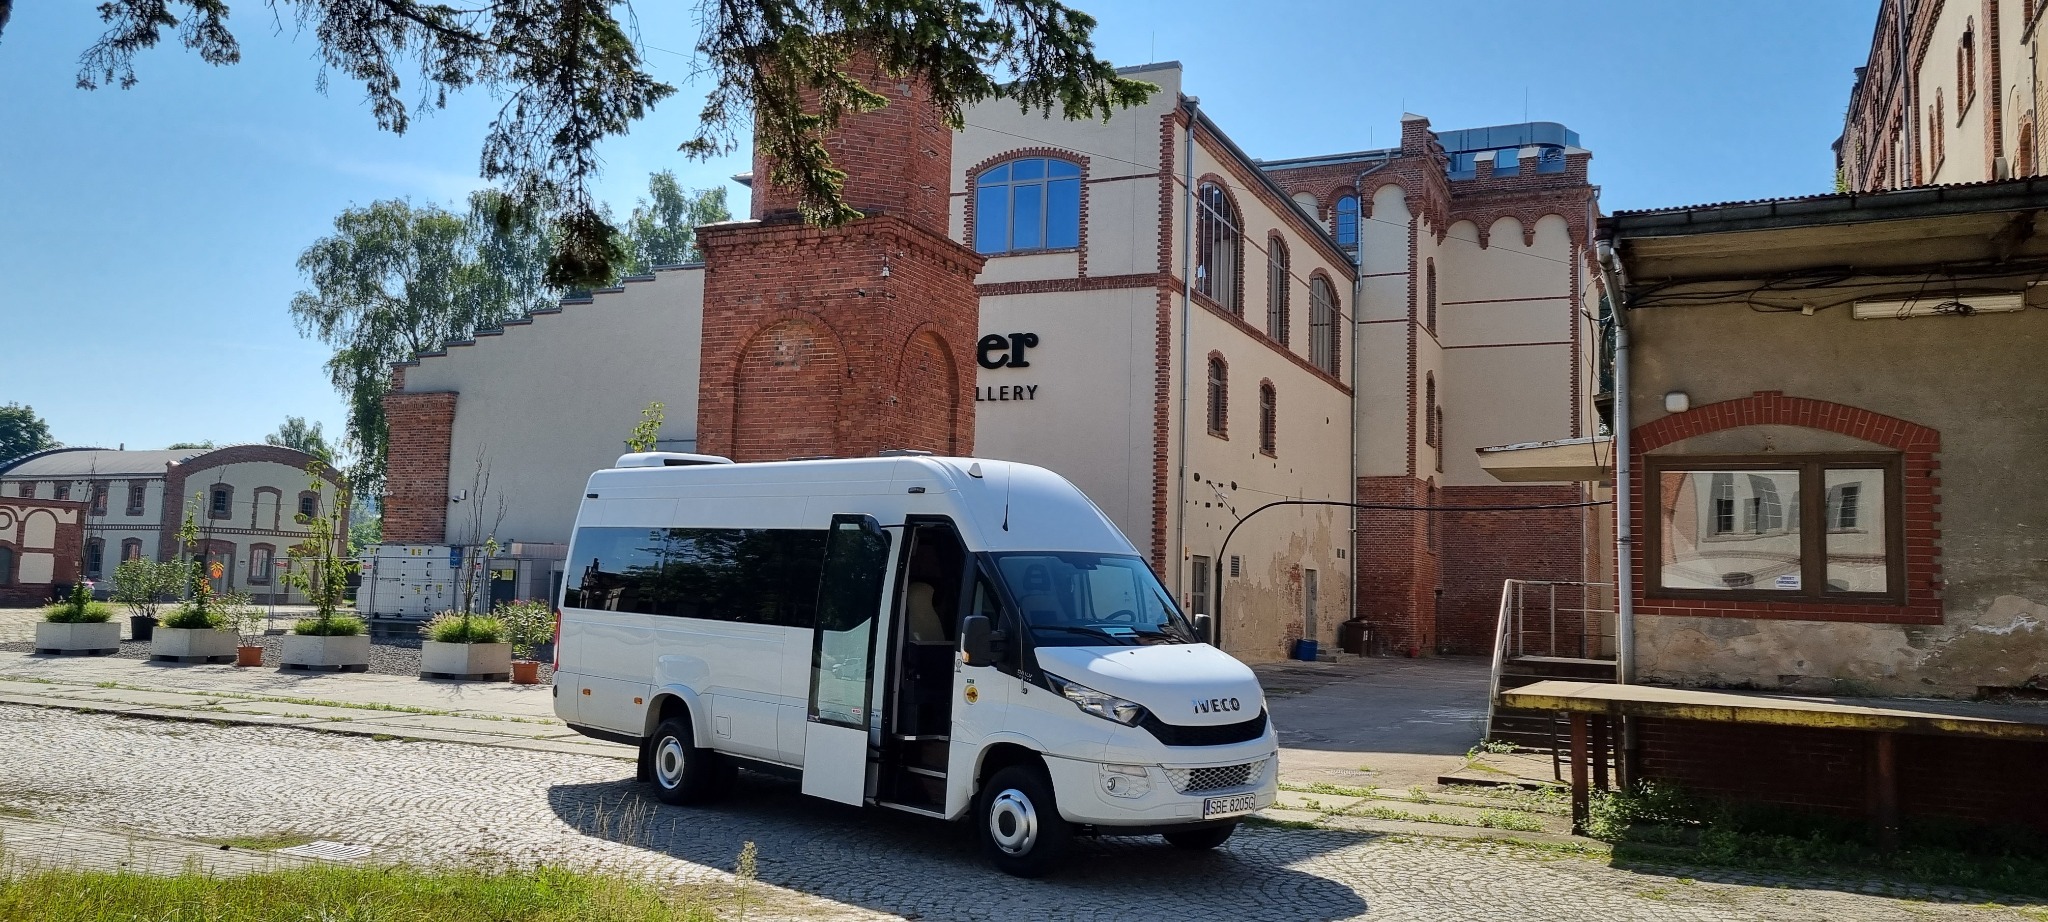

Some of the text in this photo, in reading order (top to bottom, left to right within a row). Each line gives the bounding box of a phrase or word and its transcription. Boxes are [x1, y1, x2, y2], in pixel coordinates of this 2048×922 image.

[977, 332, 1039, 369] er
[975, 385, 1038, 402] LLERY
[1193, 697, 1240, 714] IVECO
[1210, 796, 1254, 815] SBE 8205G
